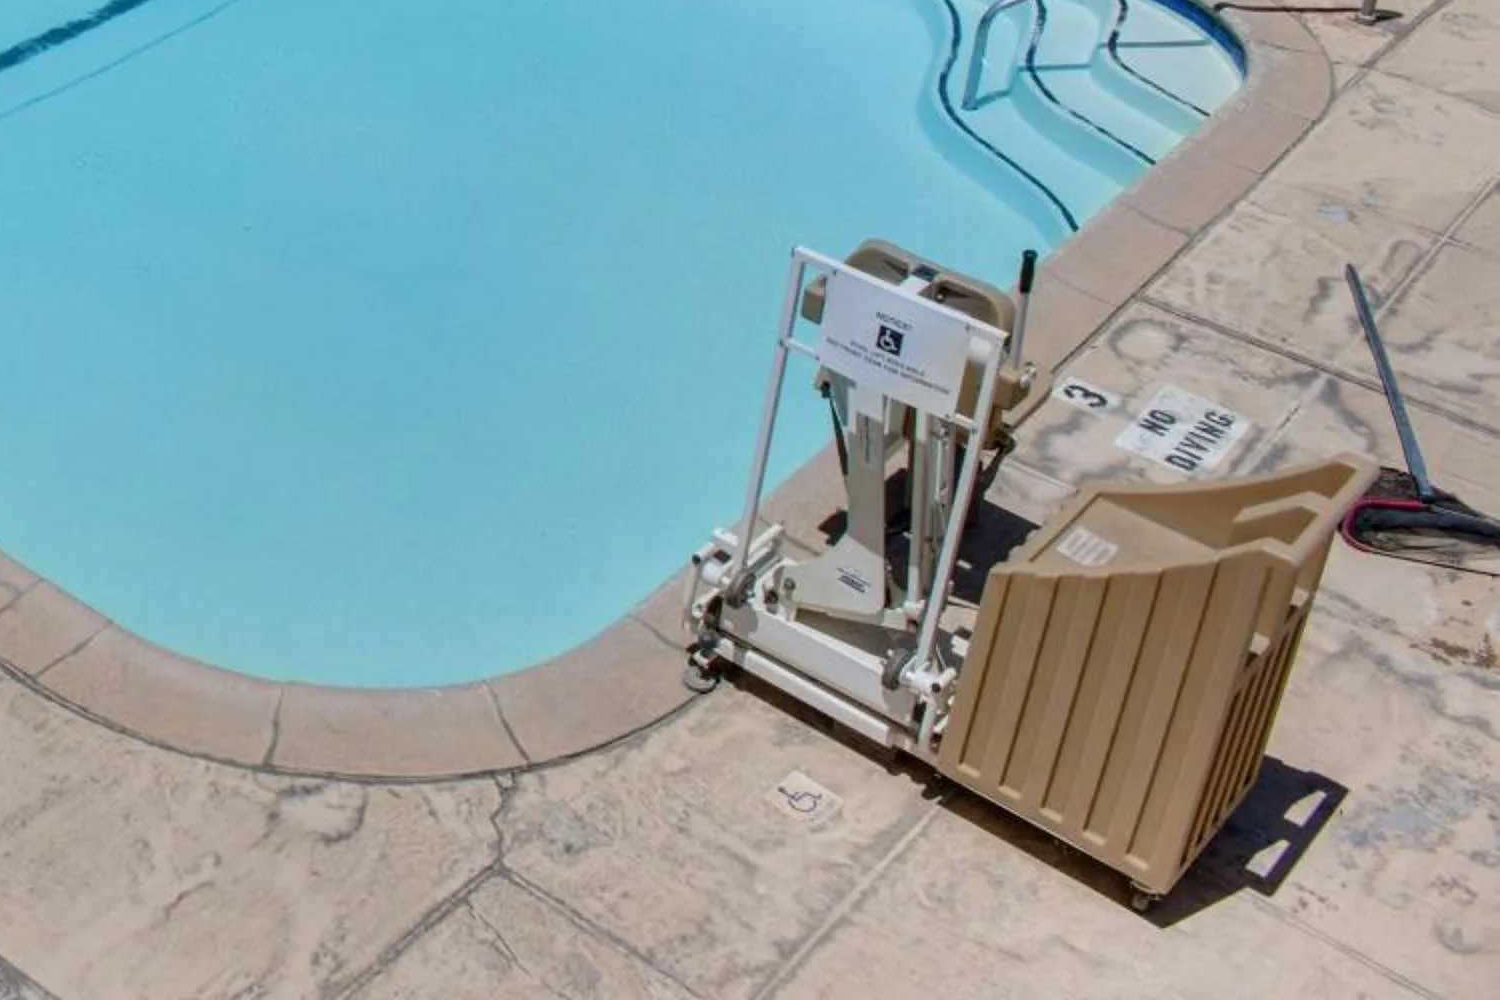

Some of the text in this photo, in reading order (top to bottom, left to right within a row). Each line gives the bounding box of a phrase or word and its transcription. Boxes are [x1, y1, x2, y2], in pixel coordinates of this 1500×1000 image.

[1063, 384, 1108, 408] 3
[1140, 408, 1177, 437] NO
[1165, 410, 1235, 472] DIVING
